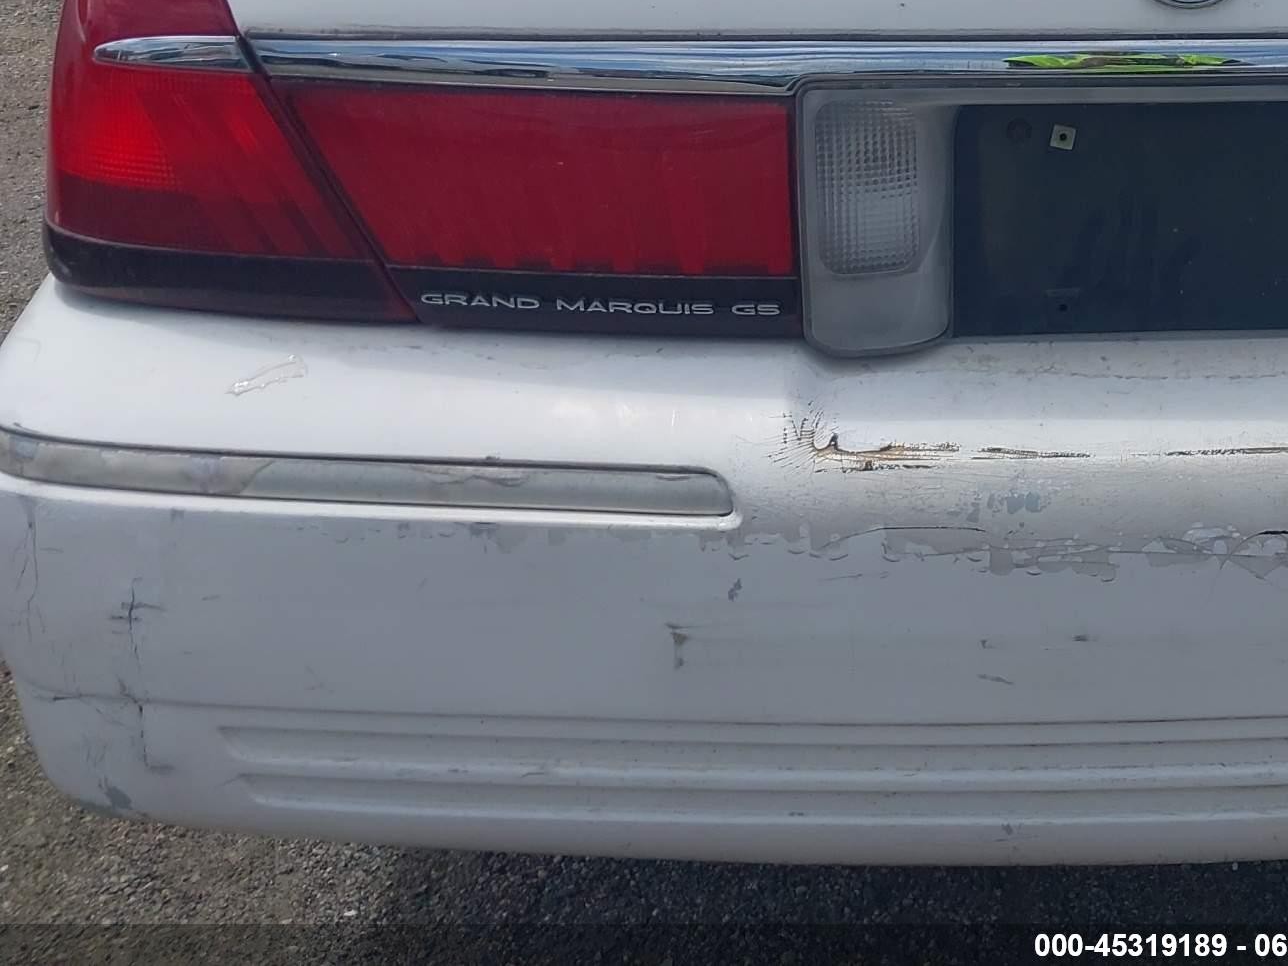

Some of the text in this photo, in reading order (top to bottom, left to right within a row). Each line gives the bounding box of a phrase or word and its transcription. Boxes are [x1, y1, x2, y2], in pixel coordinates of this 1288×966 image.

[420, 293, 781, 316] GRAND MARQUIS GS
